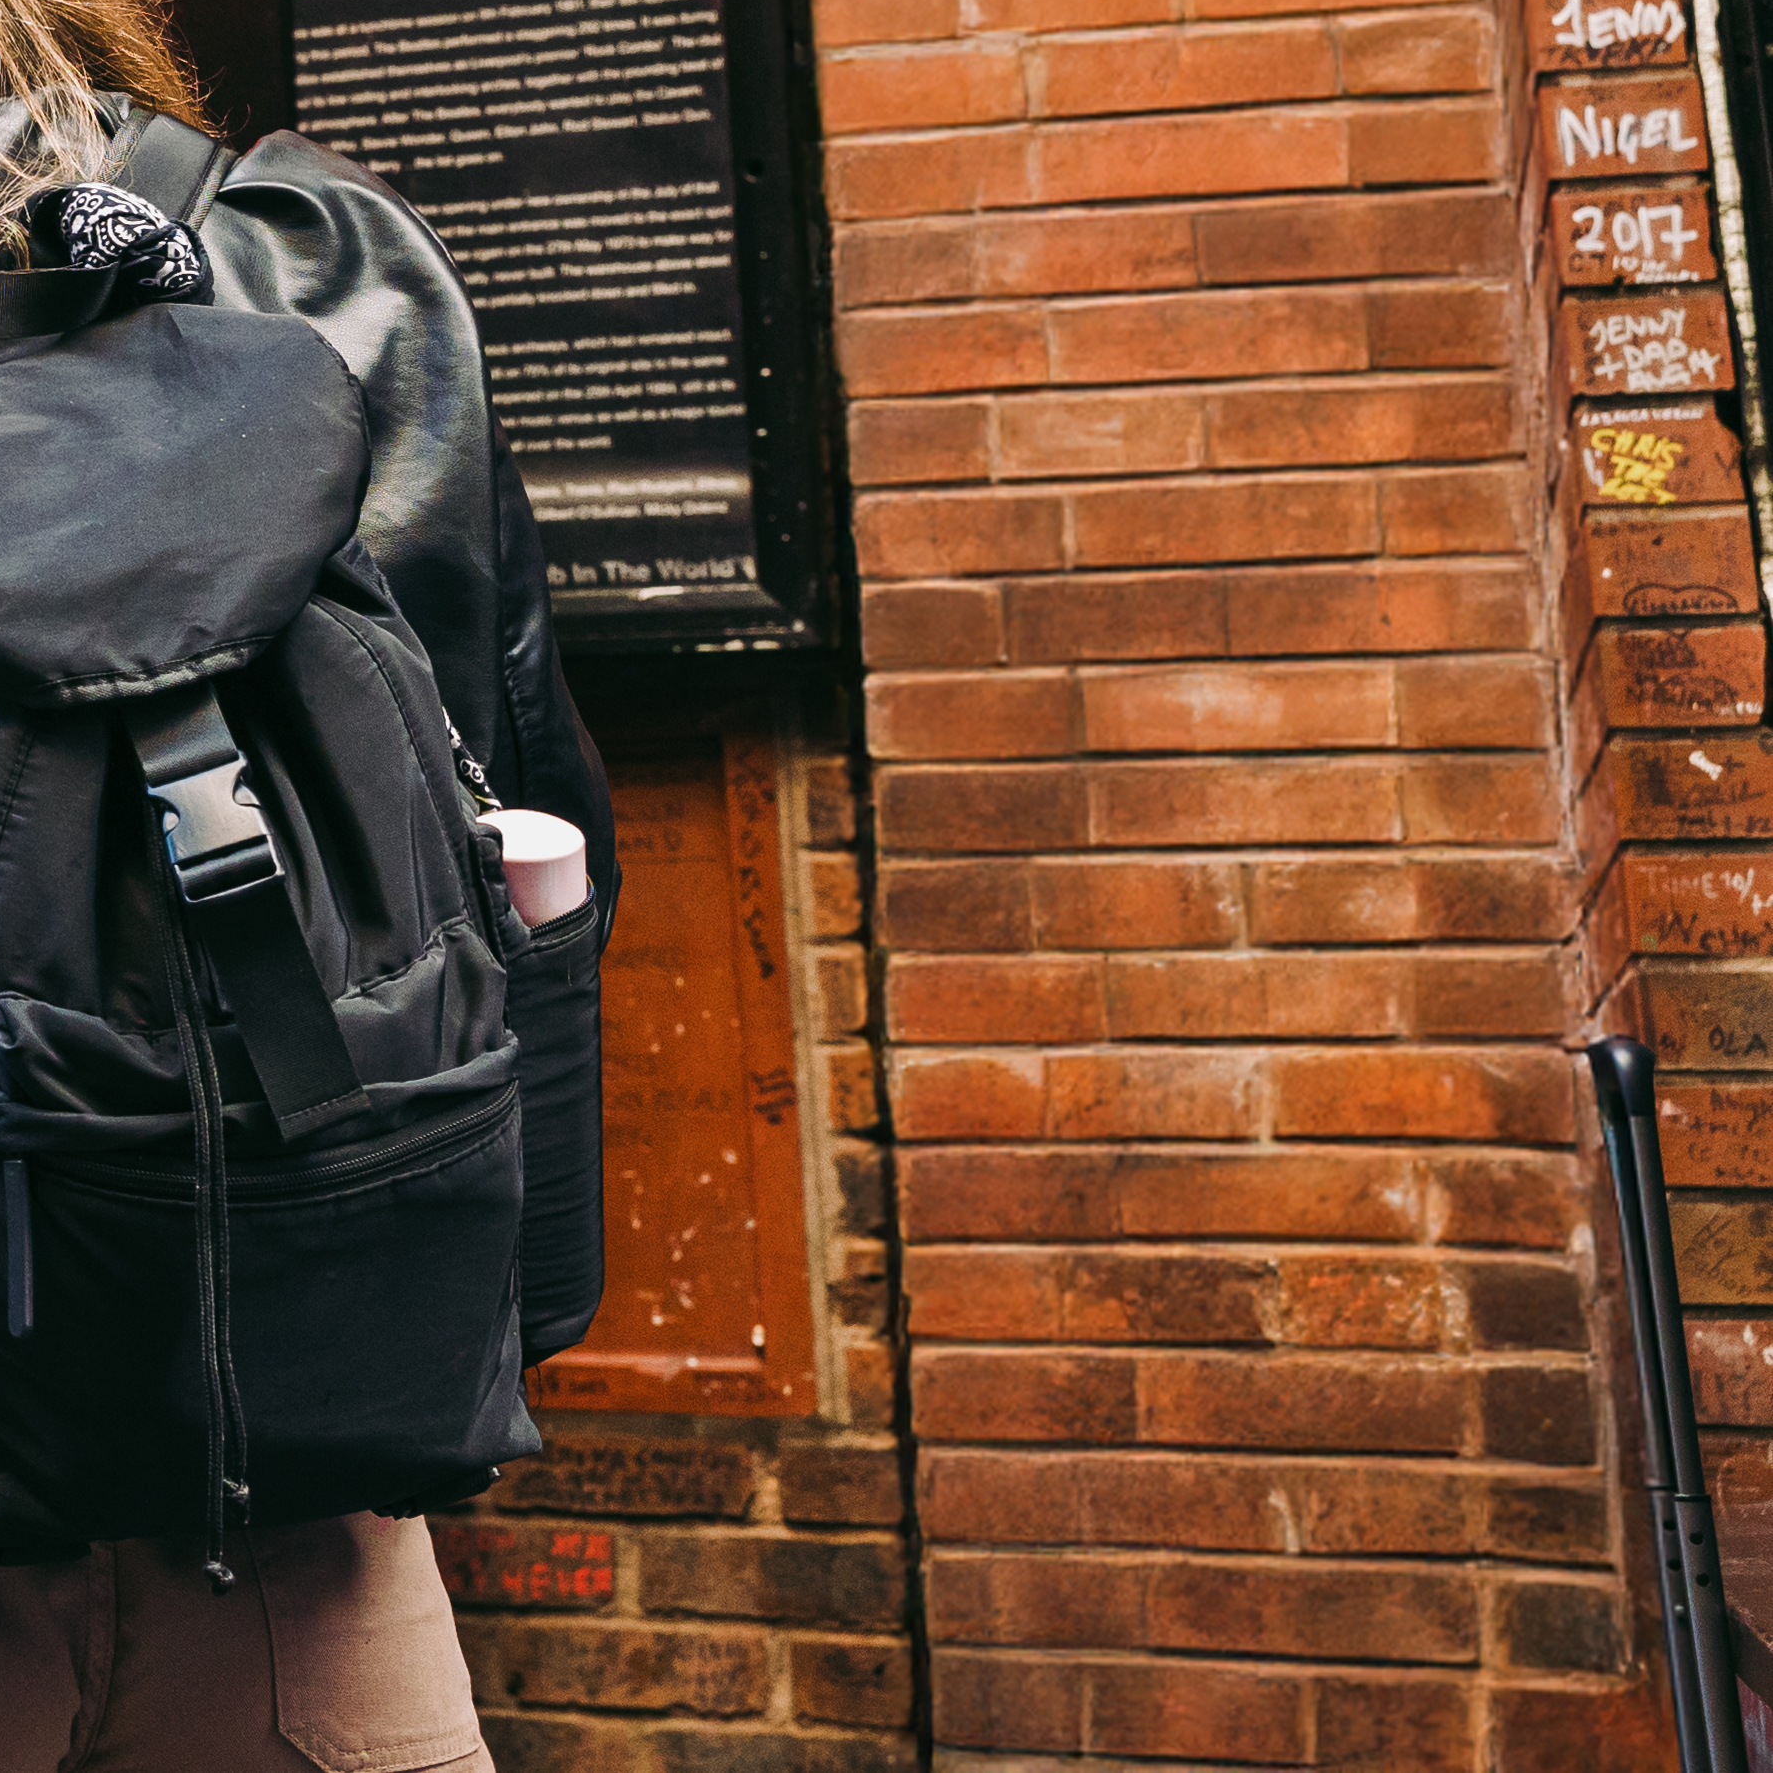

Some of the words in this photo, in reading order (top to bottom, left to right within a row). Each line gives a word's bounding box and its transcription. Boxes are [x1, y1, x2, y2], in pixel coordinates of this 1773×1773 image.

[1558, 104, 1699, 167] NIGEL
[1572, 204, 1699, 261] 2017
[1588, 307, 1687, 353] JENNY
[571, 562, 598, 583] In
[602, 559, 651, 582] The
